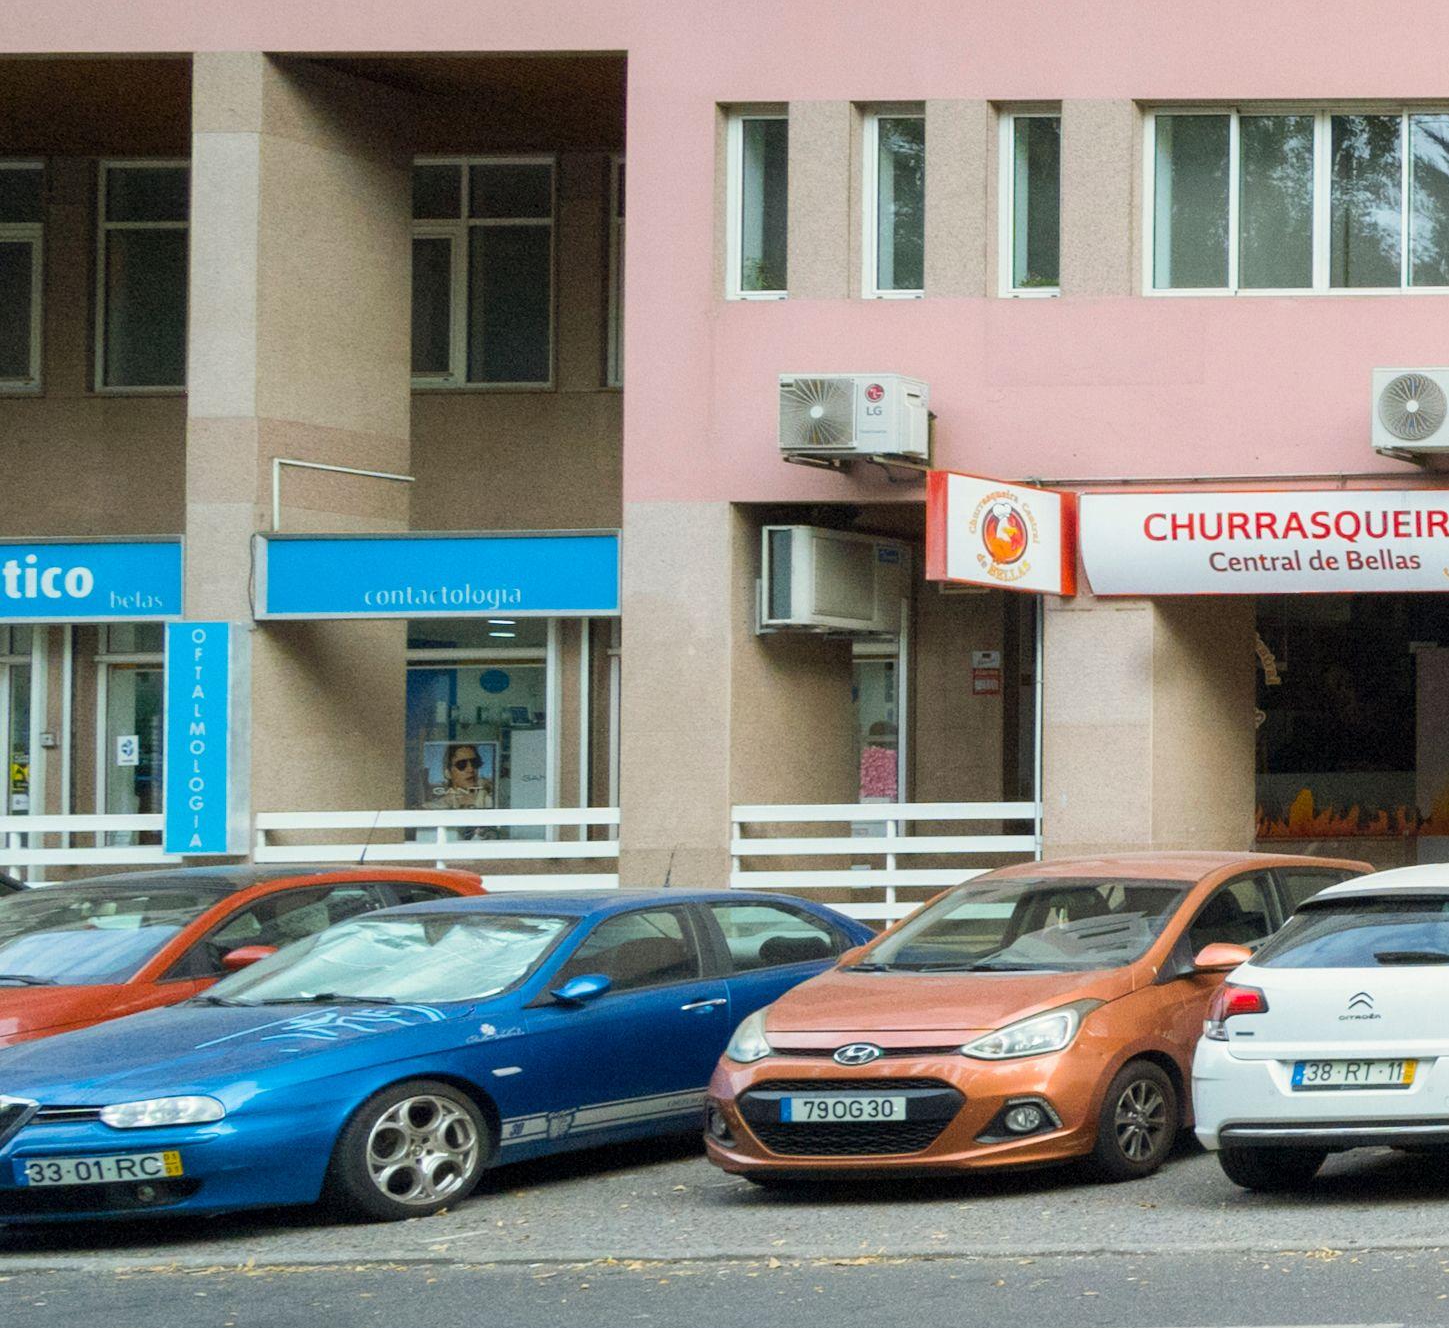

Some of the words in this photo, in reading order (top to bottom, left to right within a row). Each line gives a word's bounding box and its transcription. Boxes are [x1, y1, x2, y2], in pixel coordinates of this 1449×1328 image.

[866, 406, 883, 416] LG
[1209, 550, 1301, 572] Central
[1309, 550, 1340, 570] de
[1346, 549, 1421, 571] Bellas
[110, 591, 163, 608] belas
[364, 584, 521, 609] contactologia
[189, 628, 207, 848] OFTALMOLOGIA
[433, 786, 484, 796] GANT
